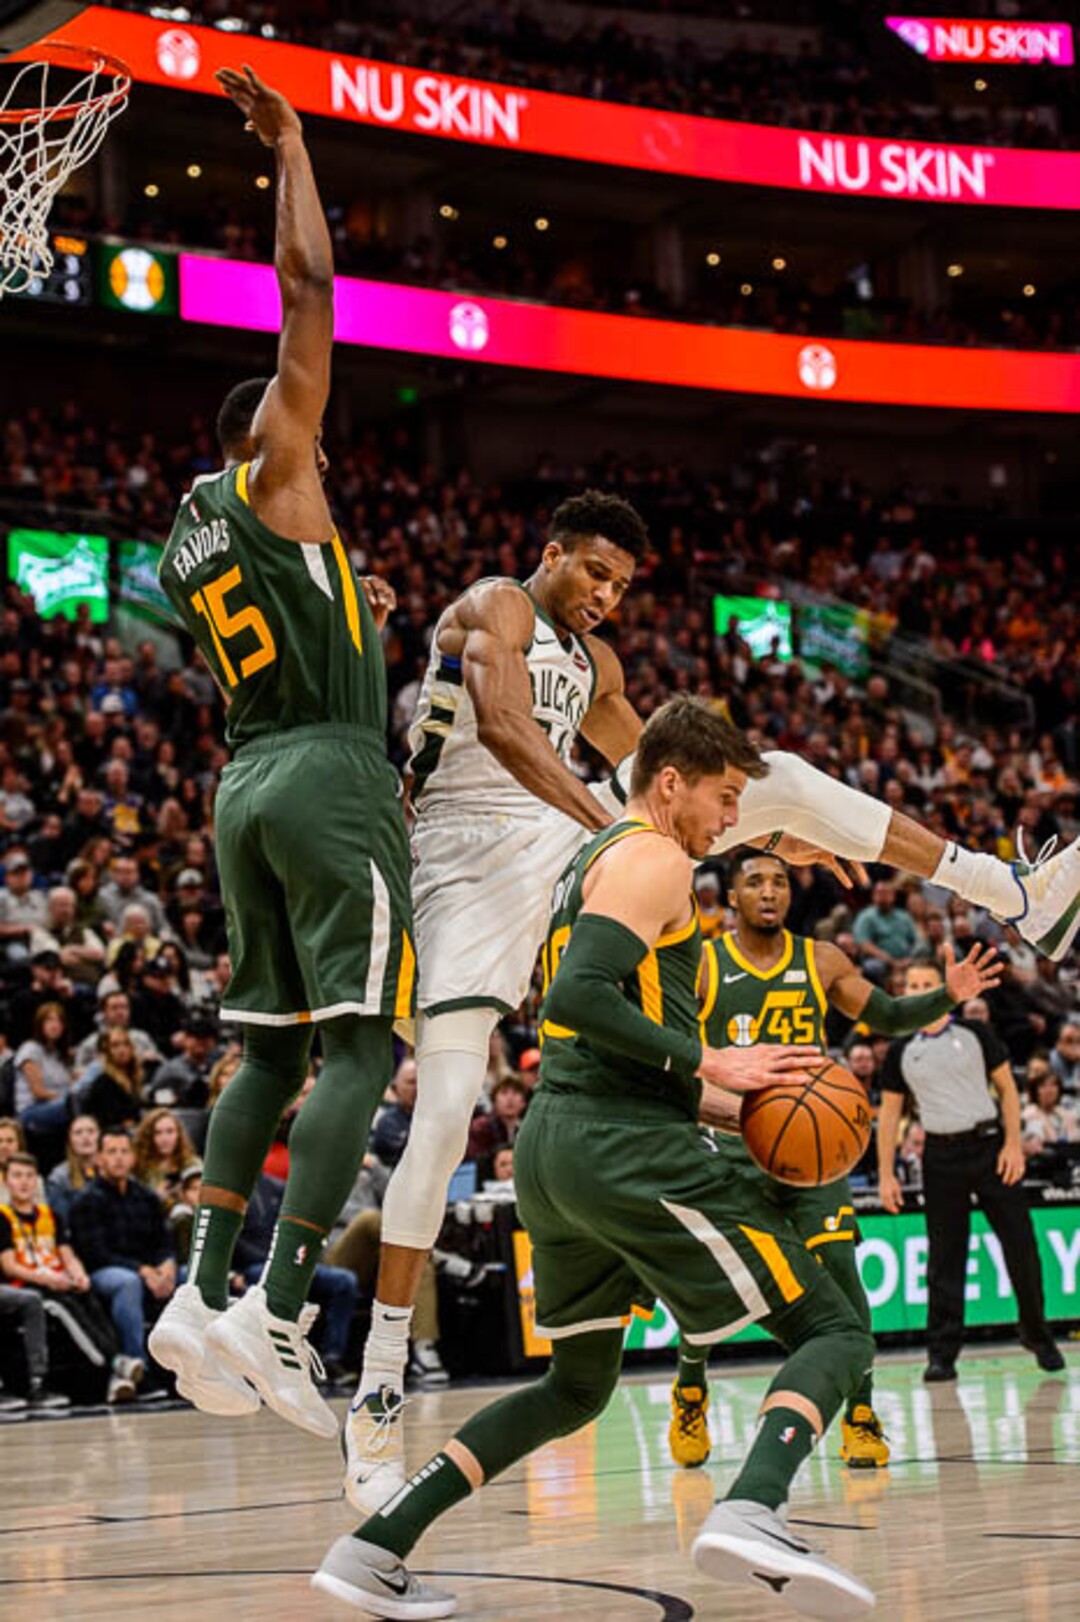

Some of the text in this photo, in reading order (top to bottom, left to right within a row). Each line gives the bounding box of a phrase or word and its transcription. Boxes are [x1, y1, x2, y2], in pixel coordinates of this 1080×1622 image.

[934, 25, 1060, 59] NU SKIN
[331, 60, 519, 142] NU SKIN
[798, 136, 986, 199] NU SKIN
[173, 518, 230, 582] FAVORS
[190, 564, 277, 688] 15
[767, 1007, 815, 1045] 45
